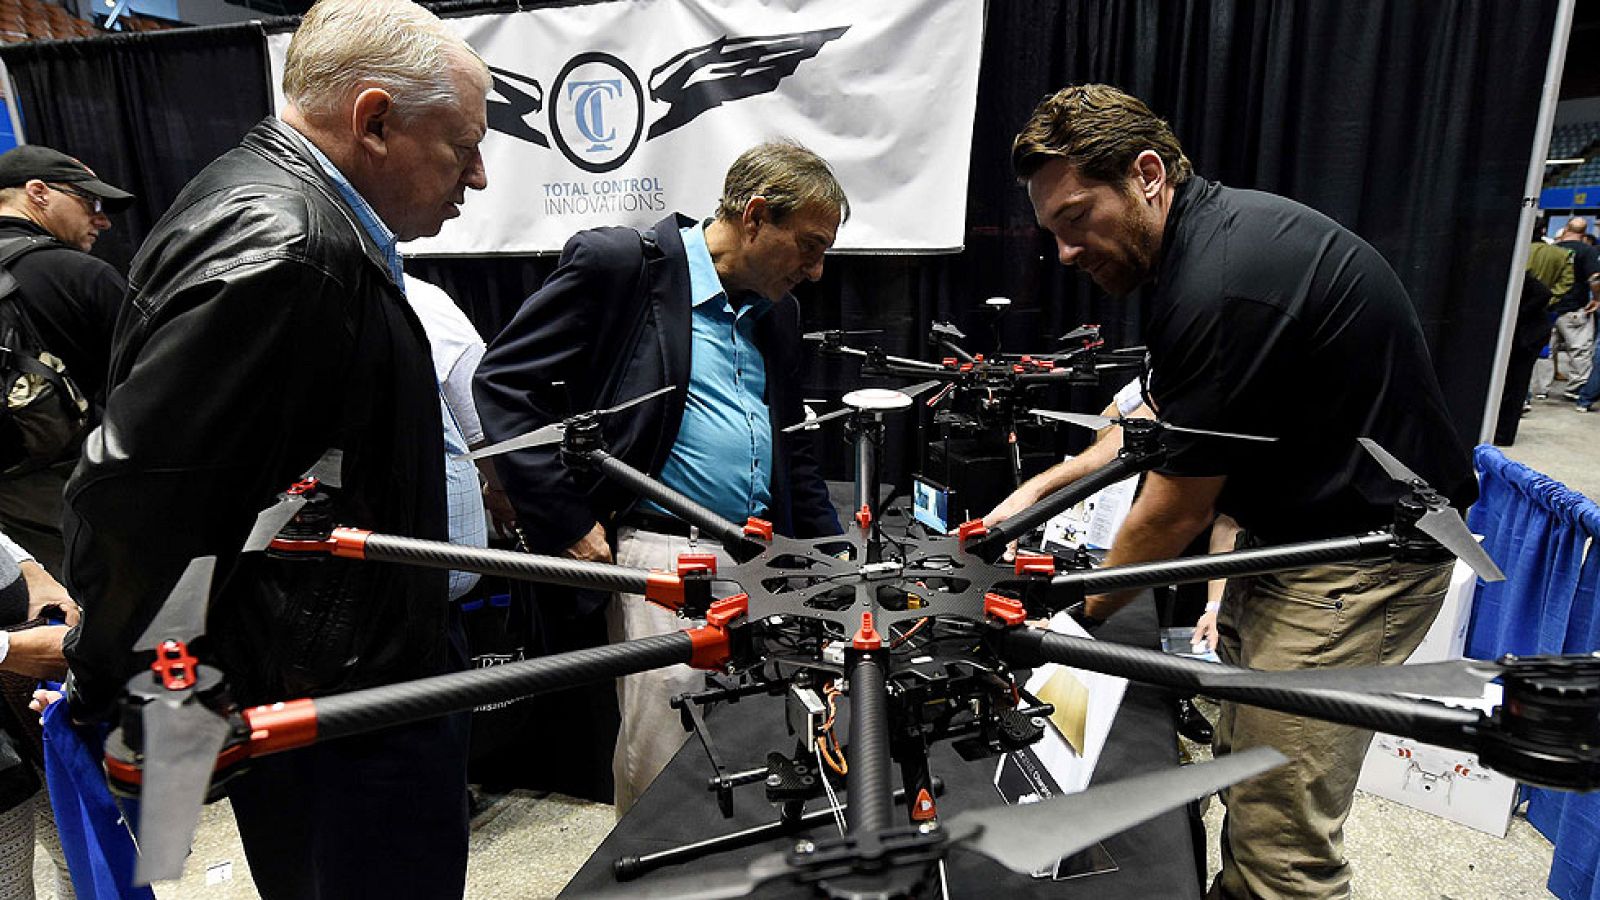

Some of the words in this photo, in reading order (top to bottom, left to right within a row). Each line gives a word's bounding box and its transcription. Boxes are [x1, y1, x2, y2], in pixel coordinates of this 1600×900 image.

[543, 182, 589, 197] TOTAL
[592, 177, 664, 195] CONTROL
[544, 192, 666, 215] INNOVATIONS
